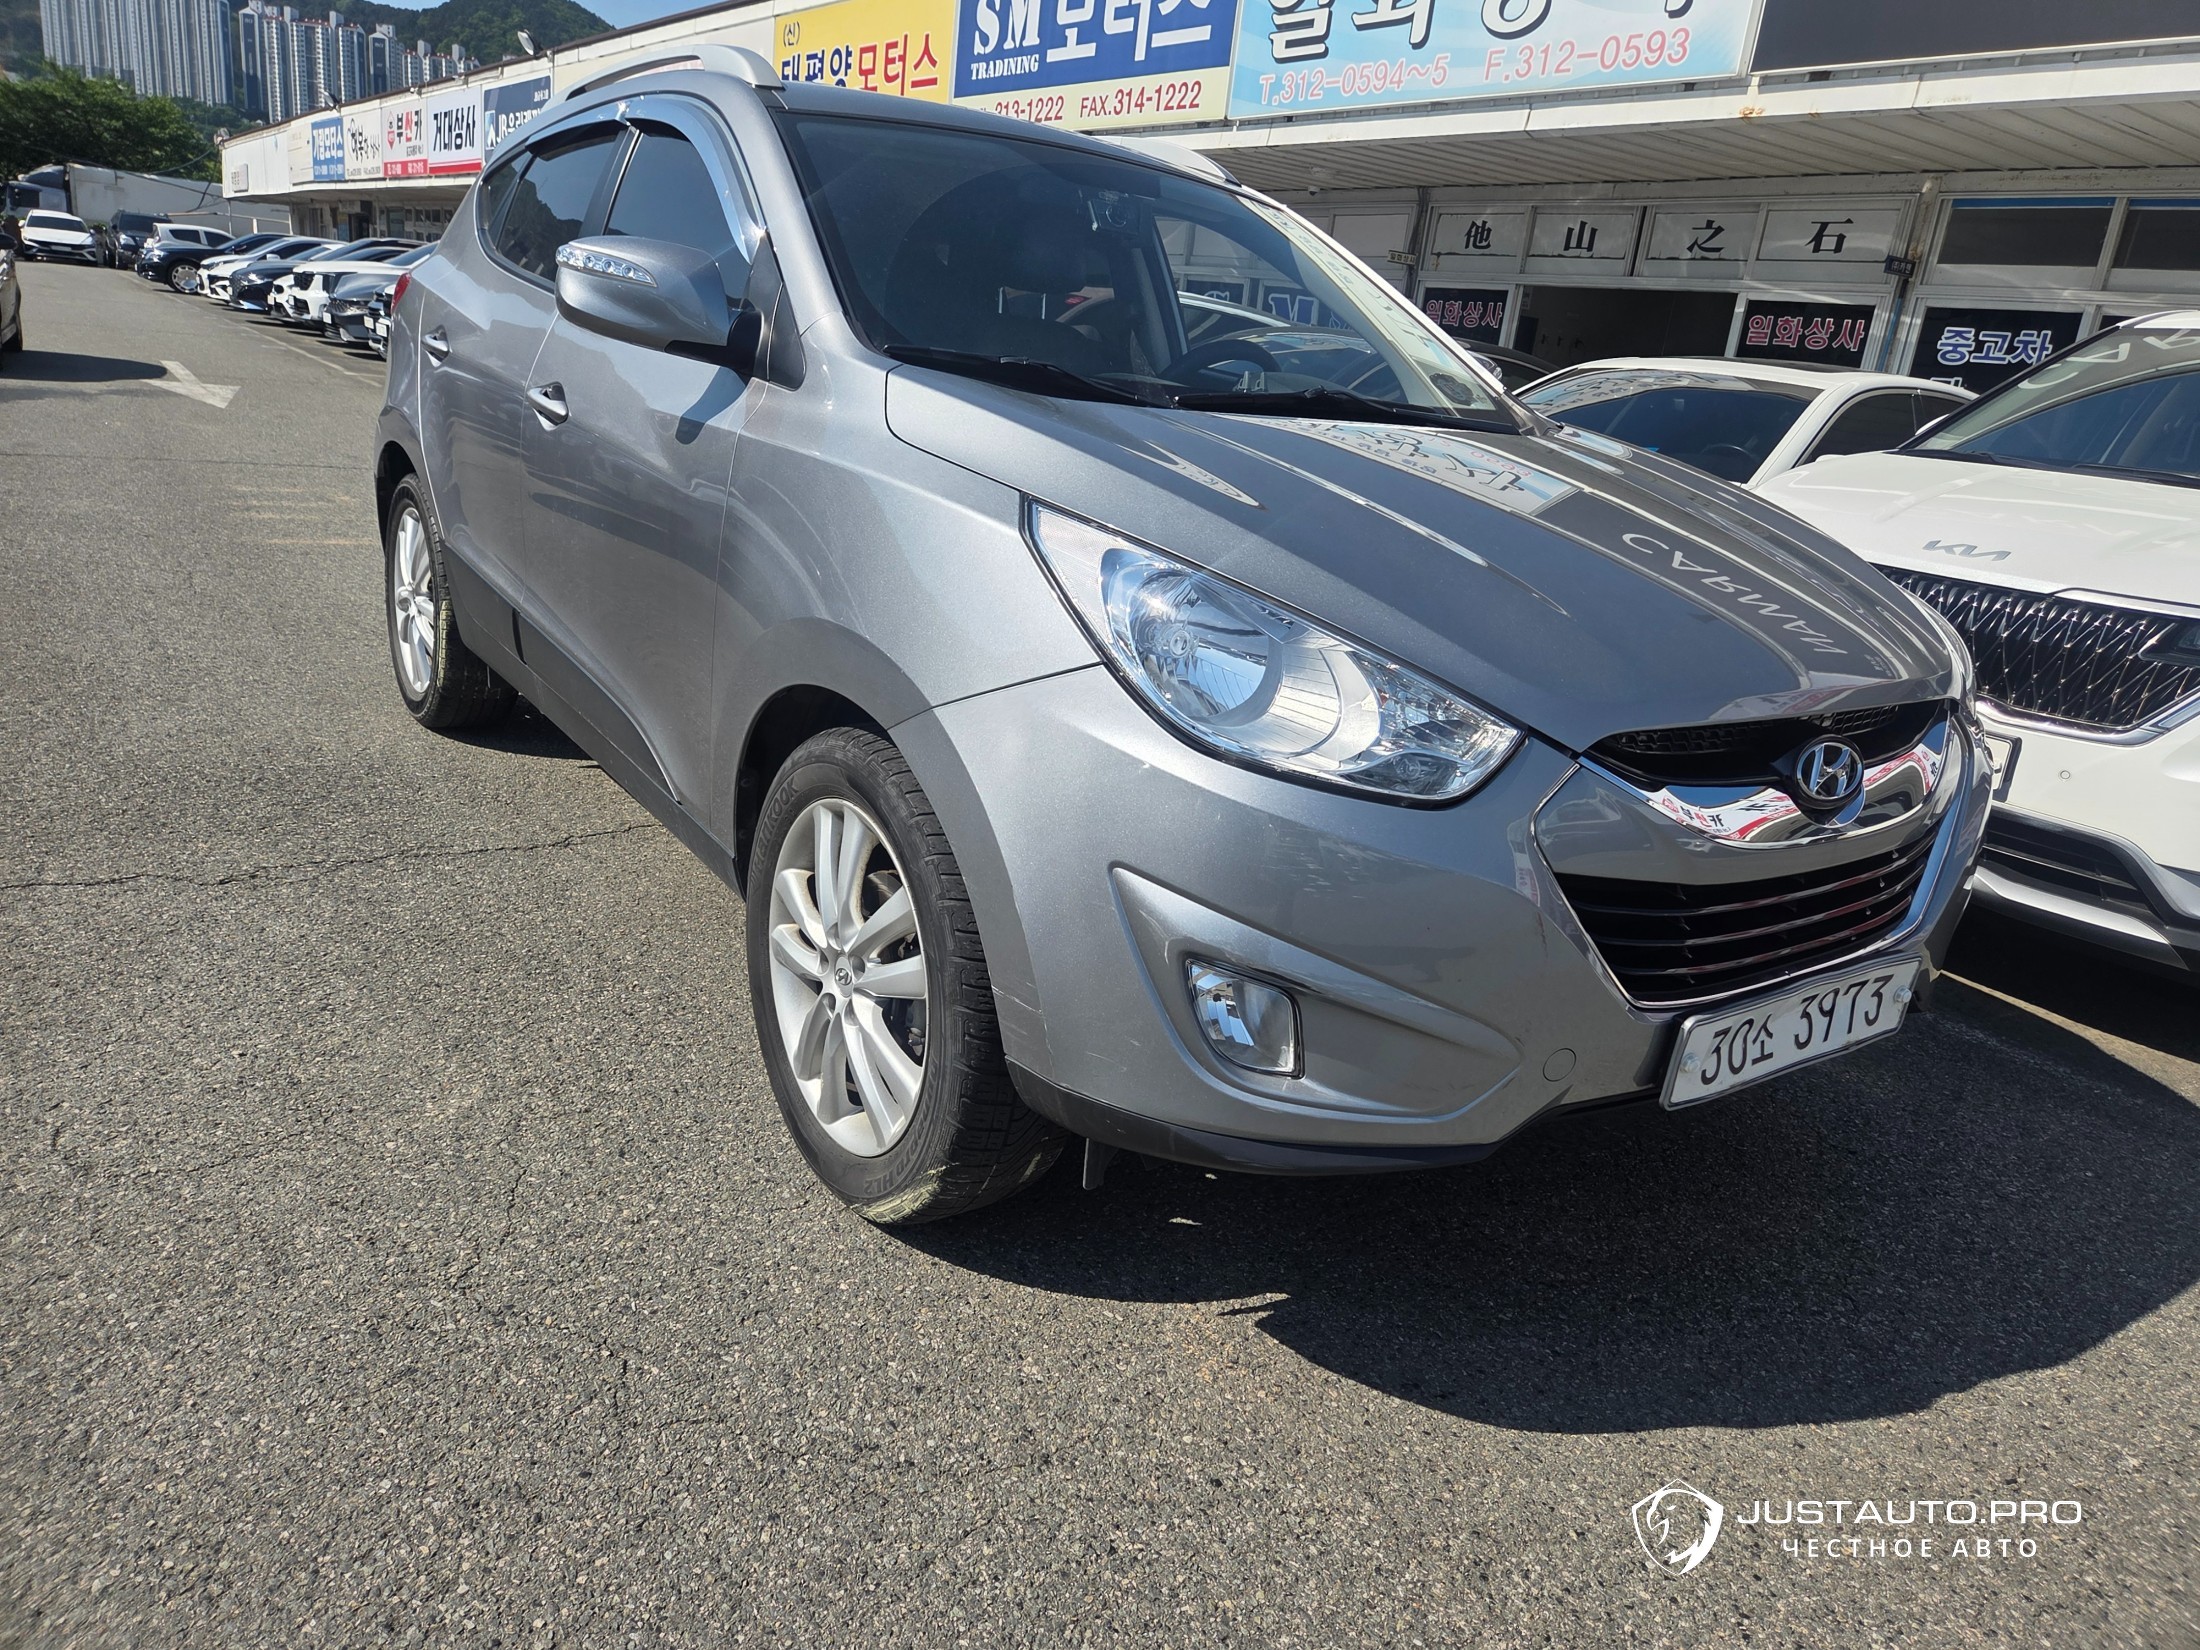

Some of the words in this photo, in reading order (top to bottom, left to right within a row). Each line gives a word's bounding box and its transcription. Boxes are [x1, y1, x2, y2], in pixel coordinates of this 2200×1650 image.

[974, 0, 1040, 56] SM
[971, 54, 1039, 80] TRADINING
[433, 105, 475, 152] 거대상사
[1426, 300, 1503, 328] 일화상사
[1746, 314, 1866, 352] 일화상사
[1937, 326, 2053, 366] 중고차
[1701, 1014, 1773, 1085] 30소
[1794, 974, 1894, 1050] 3973
